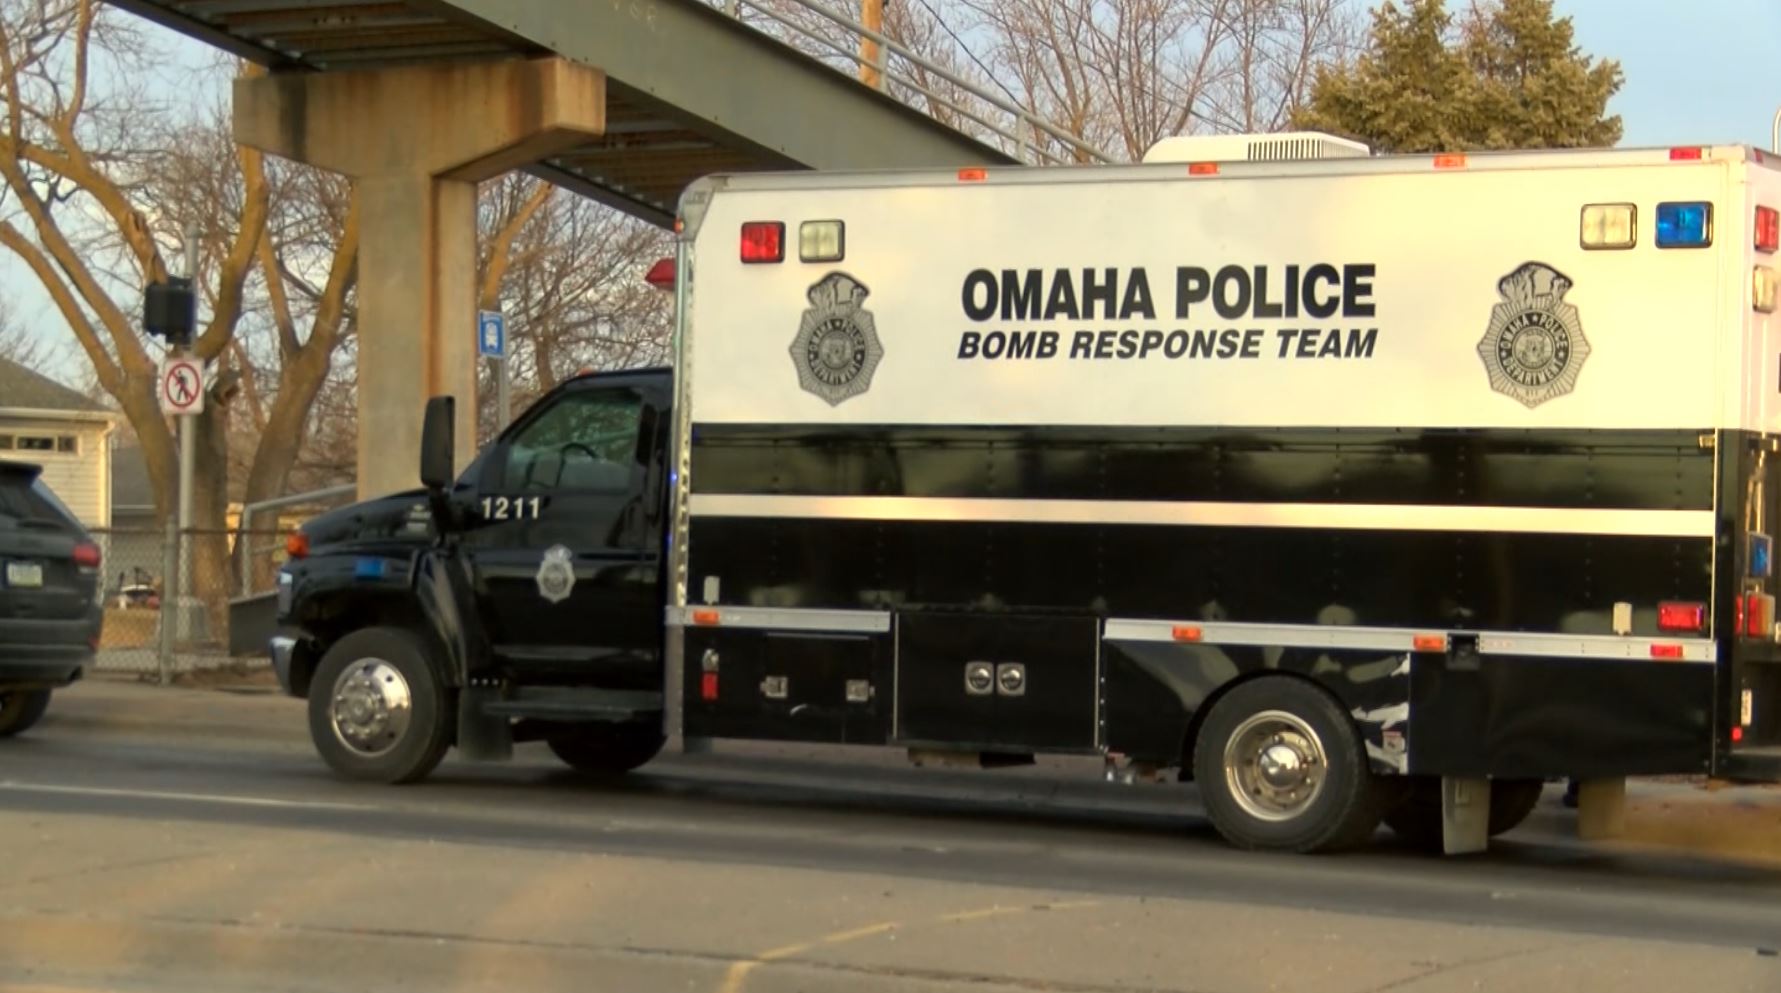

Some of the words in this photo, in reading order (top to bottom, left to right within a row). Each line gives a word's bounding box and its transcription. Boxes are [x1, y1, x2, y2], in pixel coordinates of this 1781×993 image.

[962, 267, 1156, 322] OMAHA
[1175, 263, 1376, 320] POLICE
[957, 330, 1060, 360] BOMB
[1069, 329, 1265, 359] RESPONSE
[1276, 328, 1379, 358] TEAM
[1500, 314, 1529, 350] OMAHA
[1539, 314, 1568, 349] POLICE
[1502, 357, 1564, 385] DEPARTMENT
[481, 496, 539, 519] 1211
